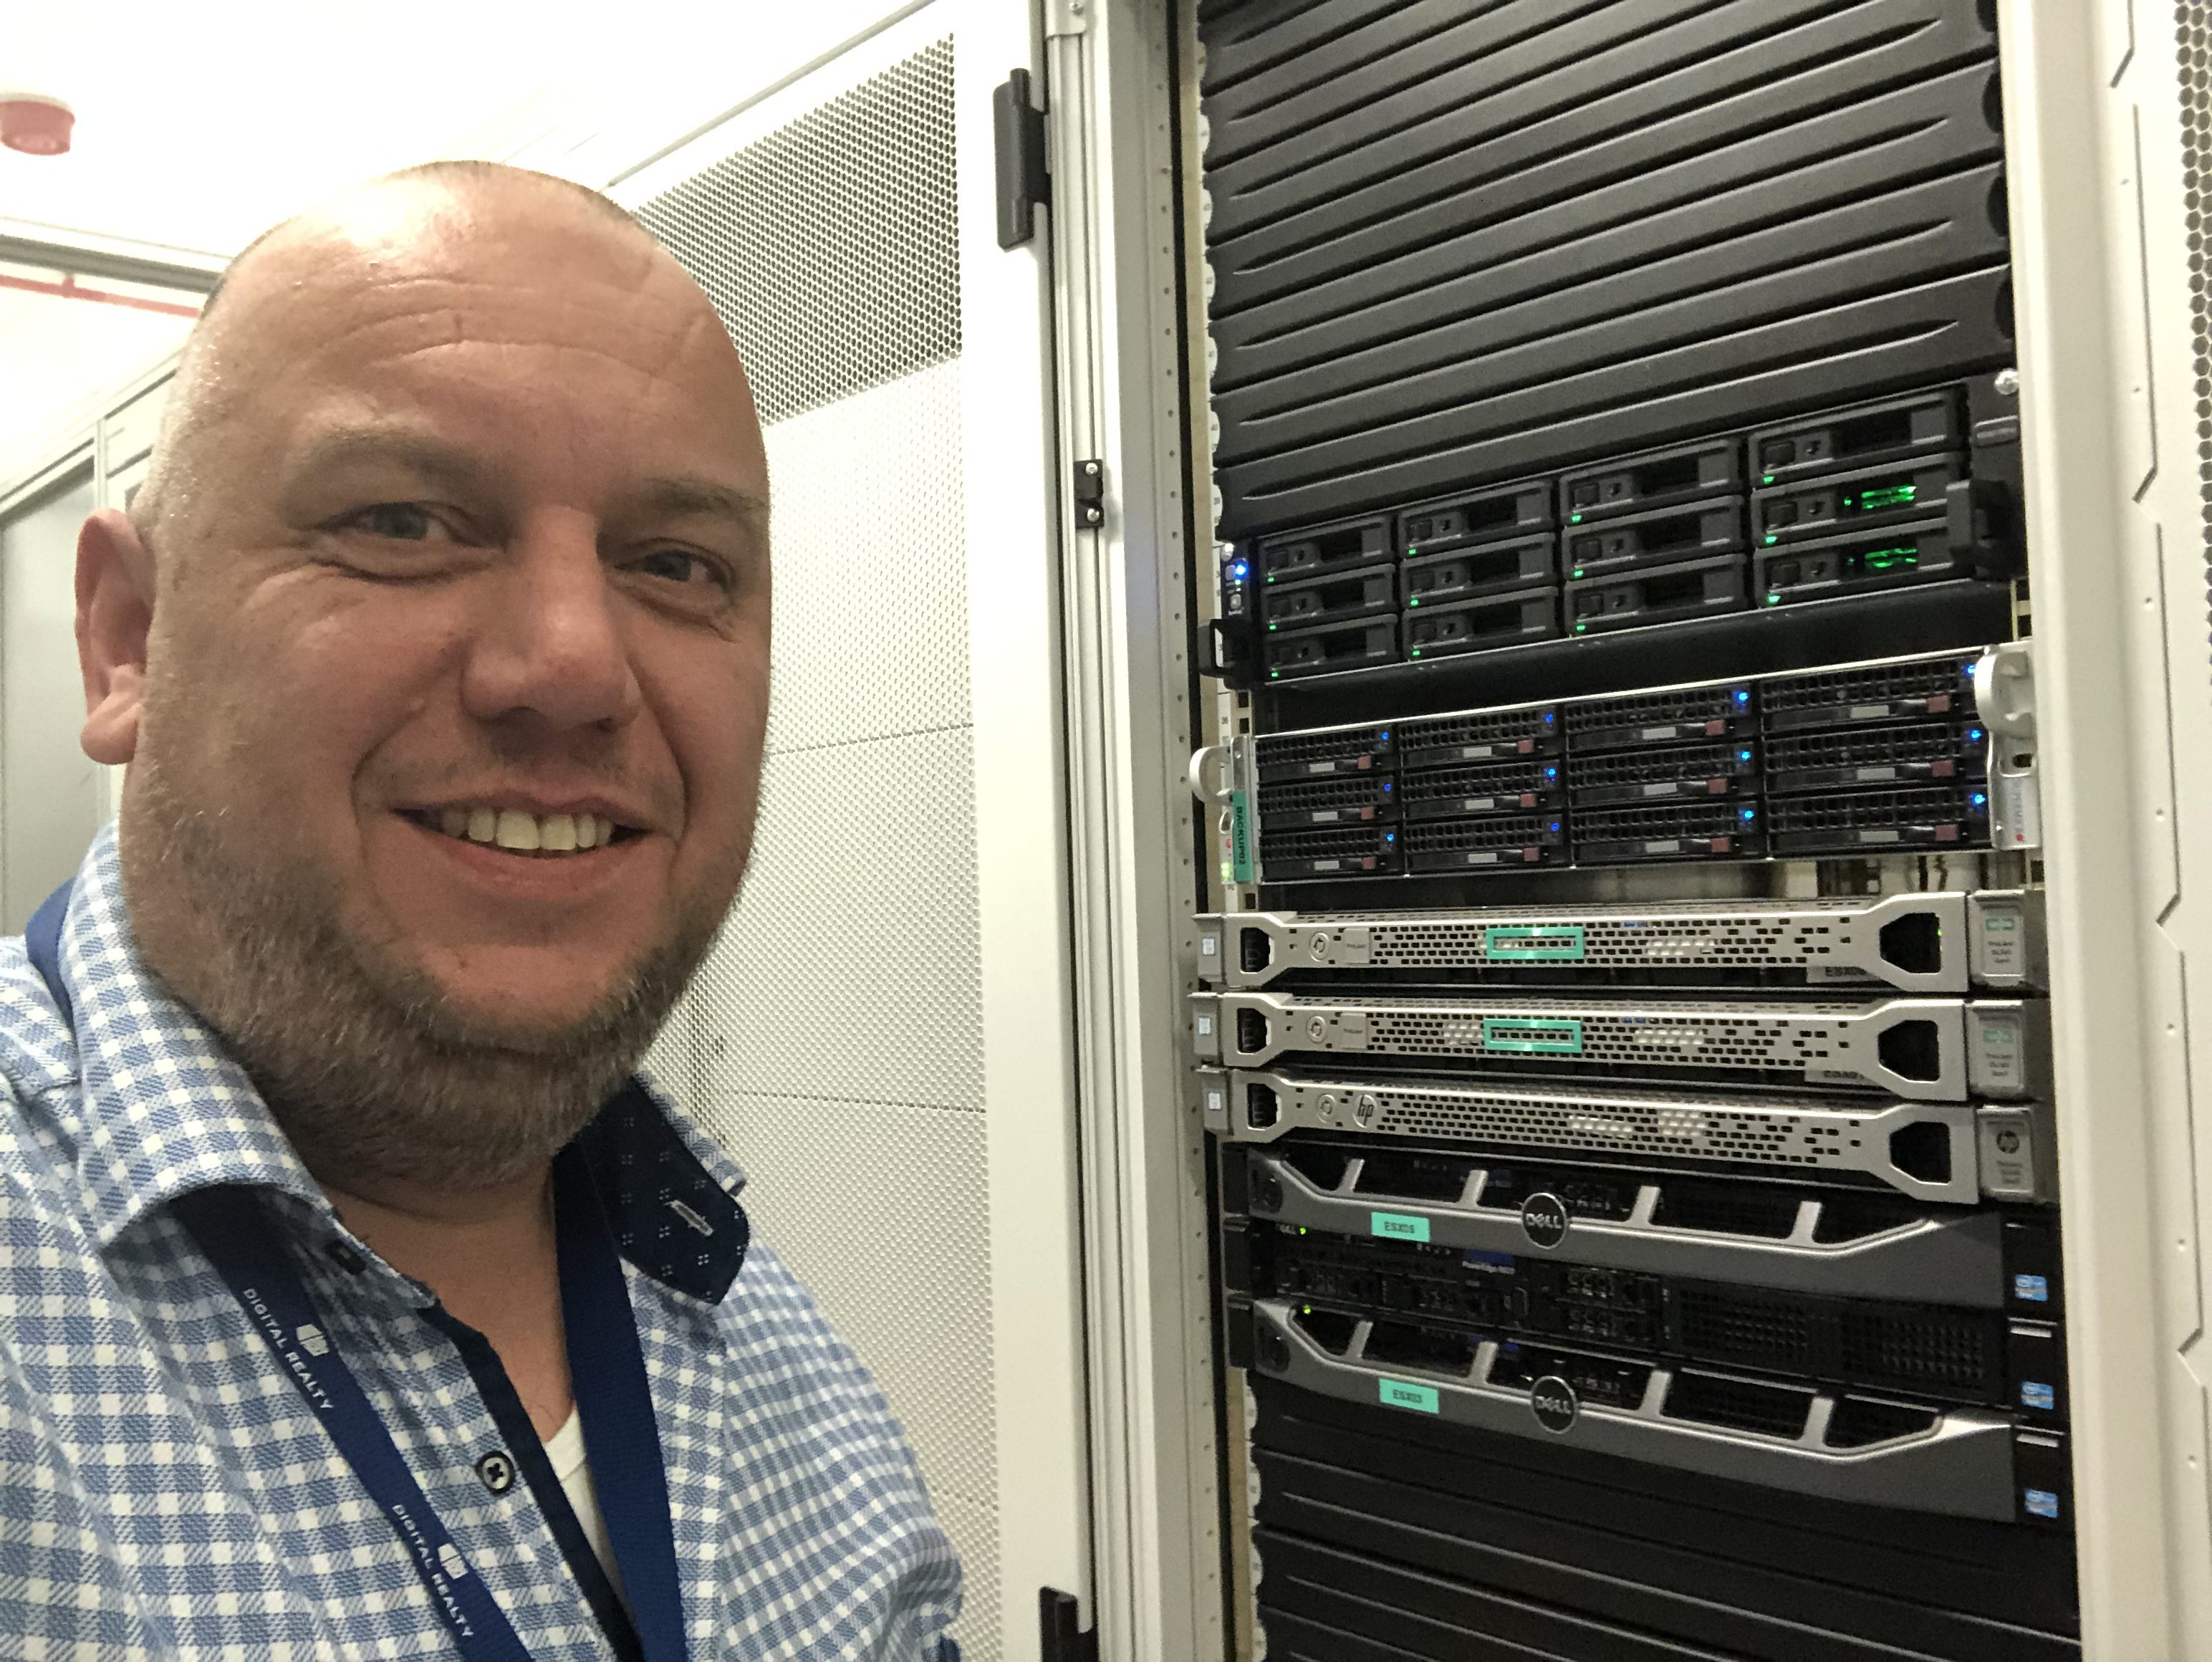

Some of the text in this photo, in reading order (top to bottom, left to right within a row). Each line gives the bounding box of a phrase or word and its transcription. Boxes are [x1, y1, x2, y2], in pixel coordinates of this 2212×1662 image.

[1235, 805, 1247, 866] BACKUP02
[1357, 1094, 1375, 1127] hp
[1525, 1213, 1562, 1229] DELL
[243, 1288, 335, 1409] DIGITAL REALTY
[1535, 1396, 1572, 1416] DELL
[392, 1504, 474, 1637] DIGITAL REALTY
